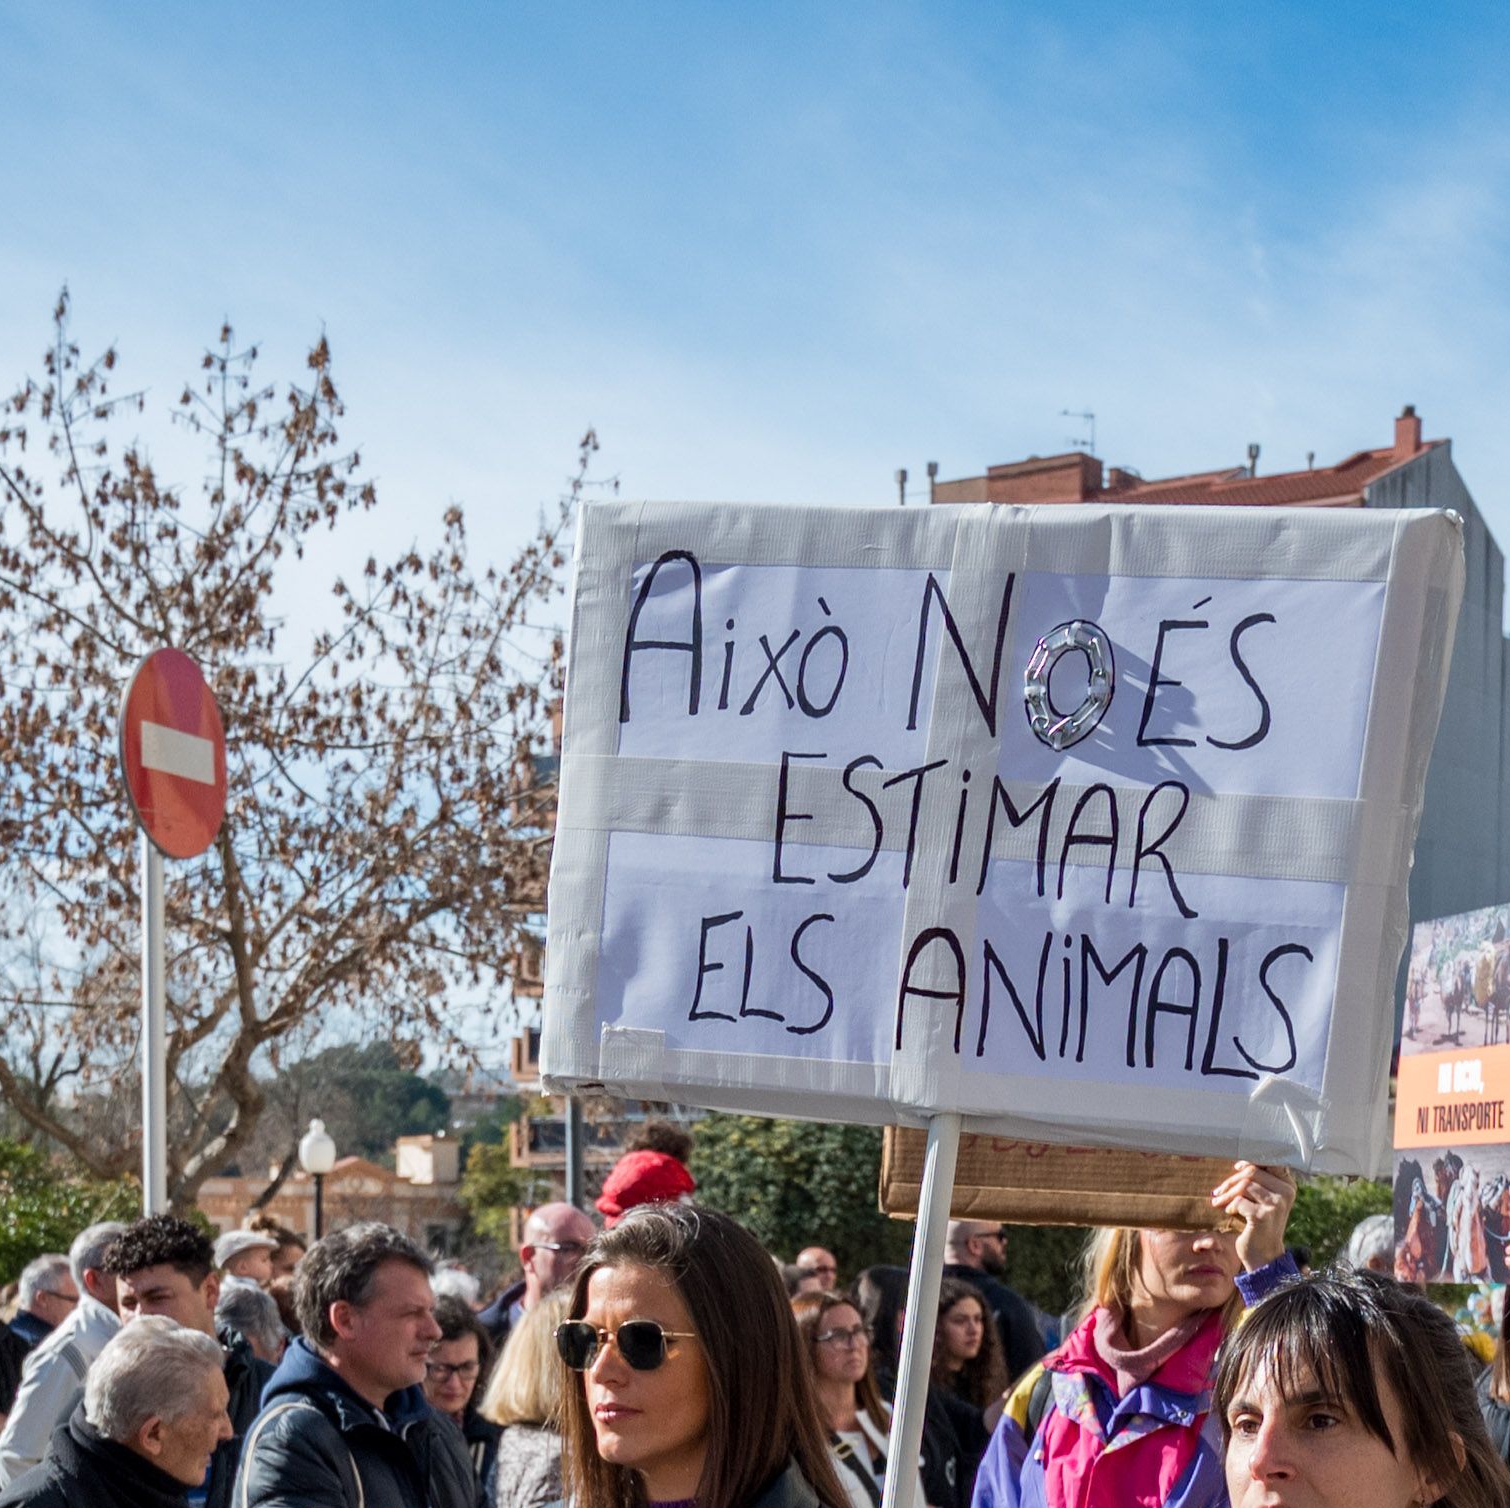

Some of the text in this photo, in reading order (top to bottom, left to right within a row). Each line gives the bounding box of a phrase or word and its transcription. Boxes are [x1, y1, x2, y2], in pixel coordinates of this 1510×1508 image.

[618, 549, 1276, 751] Això NO ÉS
[689, 911, 835, 1034] ELS
[1416, 1100, 1505, 1135] NI TRANSPORTE
